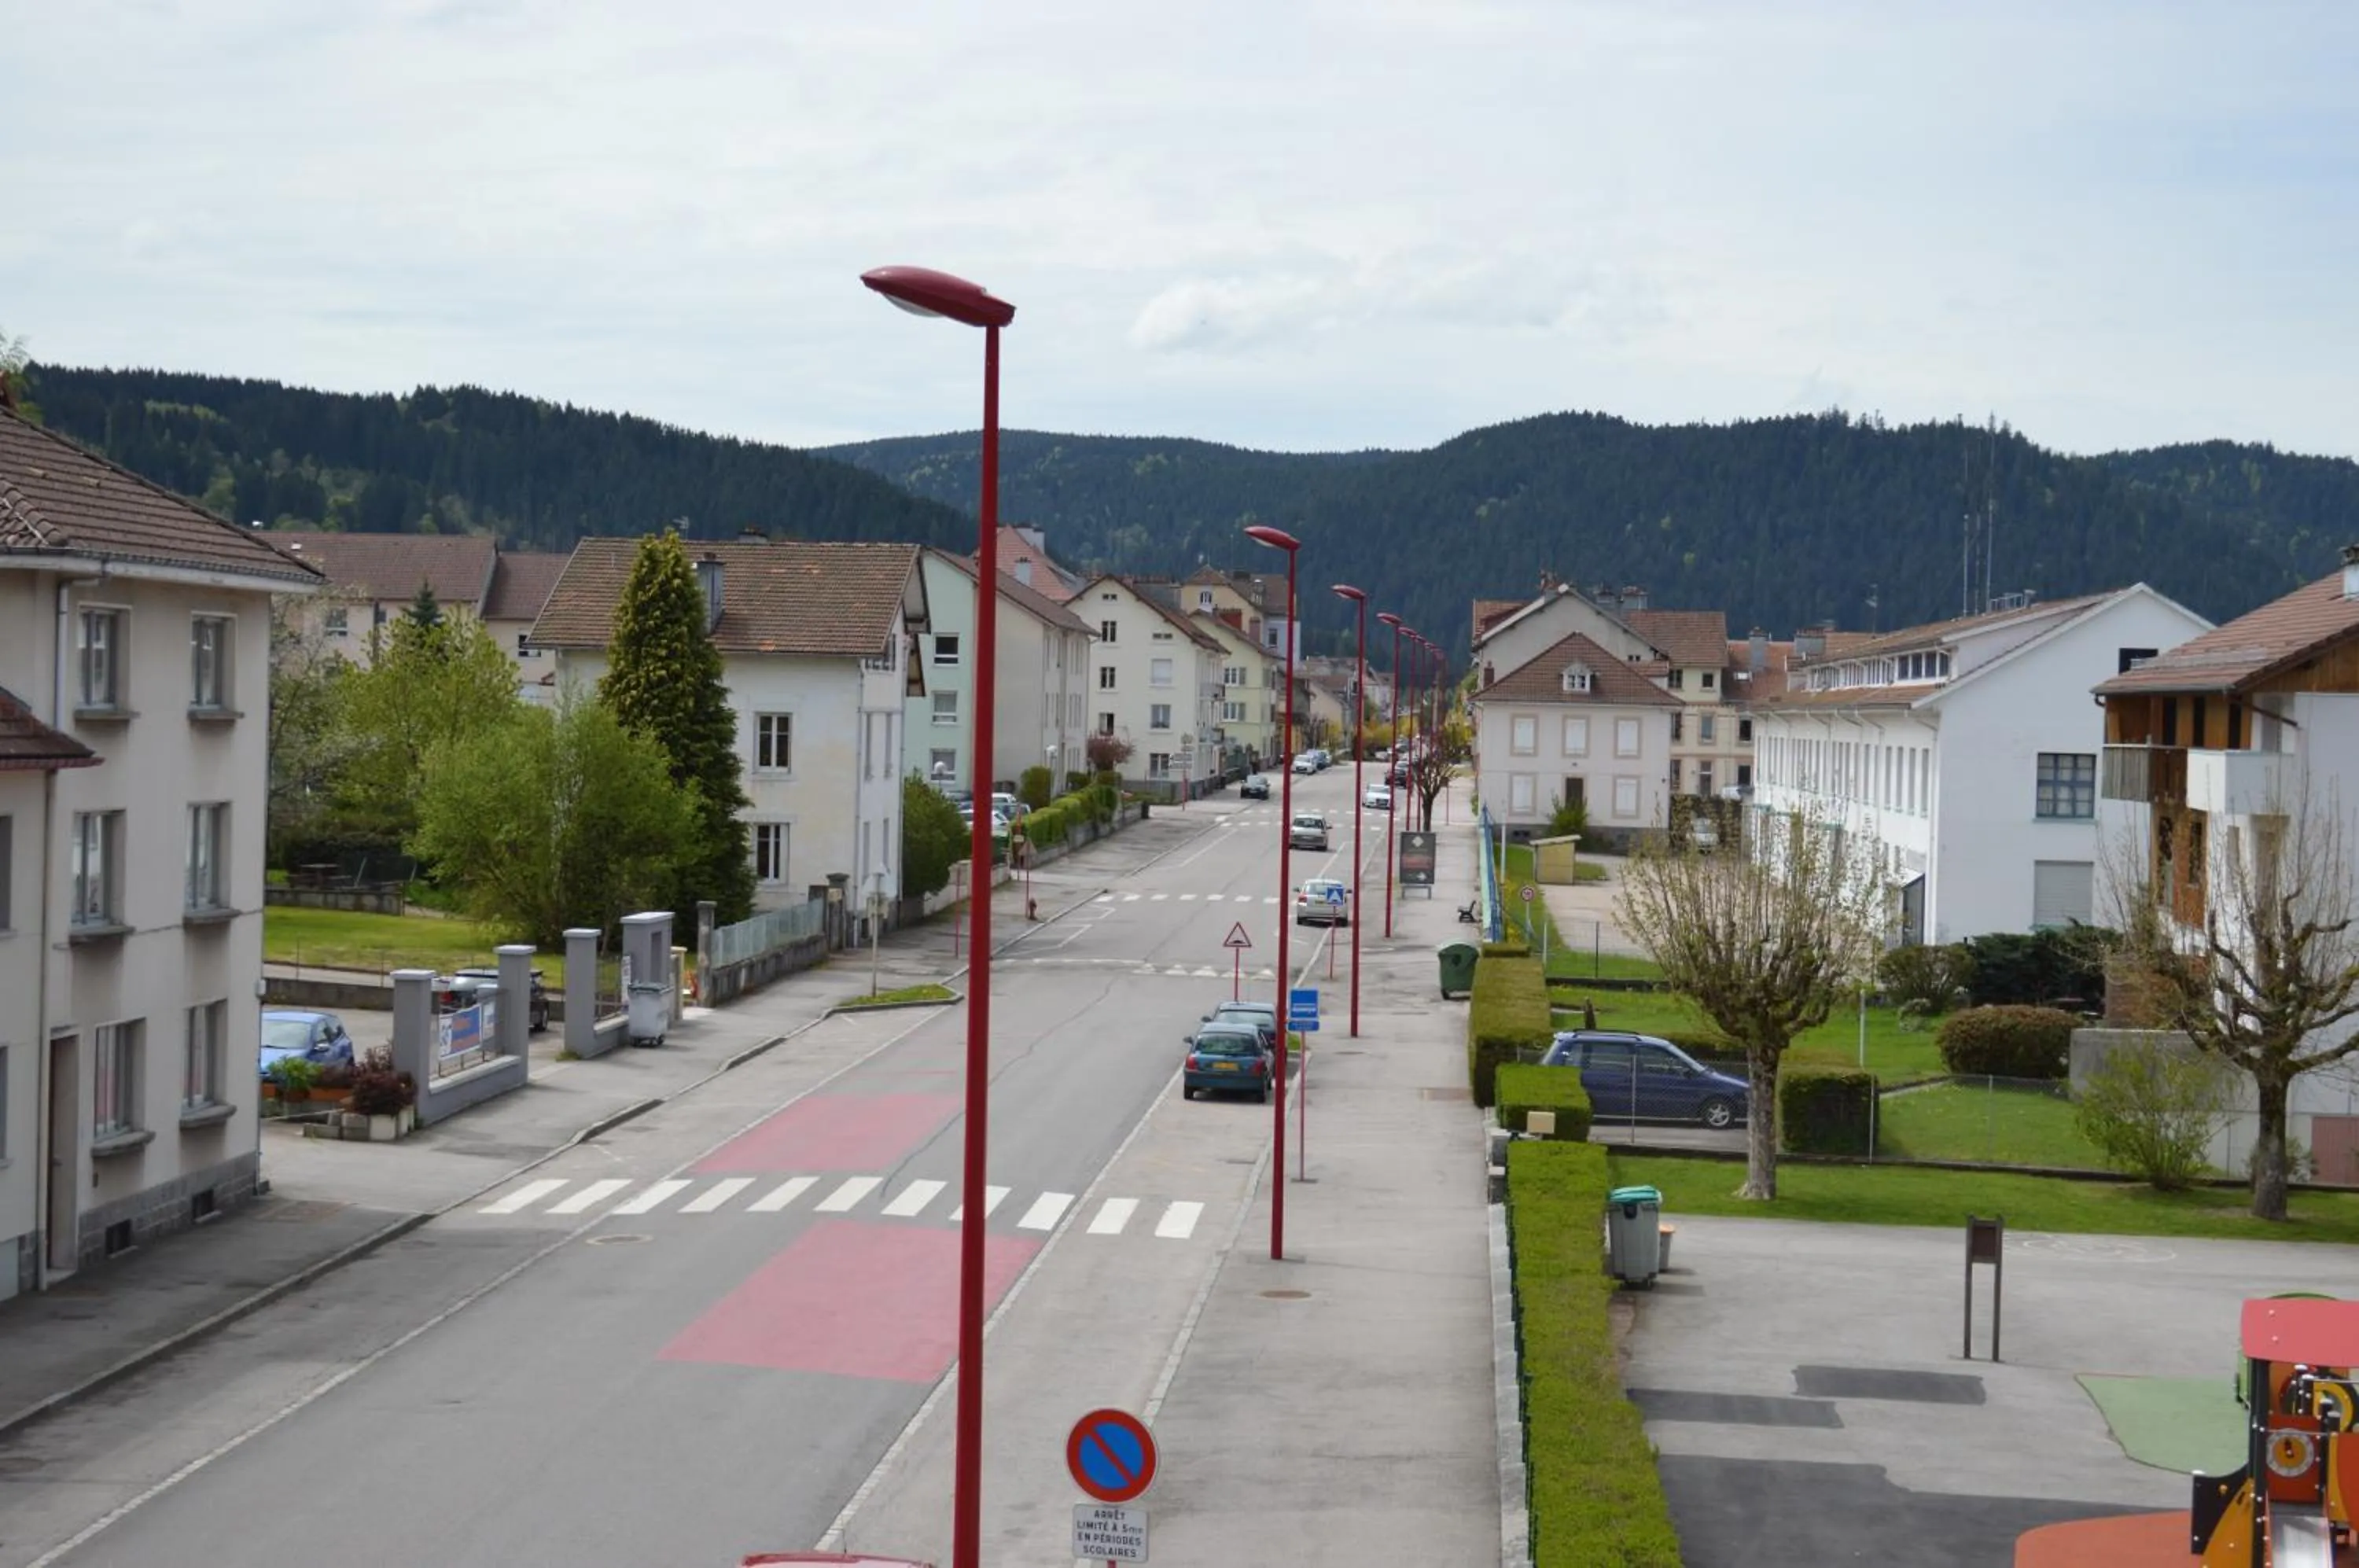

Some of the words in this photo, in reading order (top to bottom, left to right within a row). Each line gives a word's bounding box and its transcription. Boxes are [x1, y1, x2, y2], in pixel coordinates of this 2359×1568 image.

[1077, 1532, 1091, 1541] EN
[1094, 1533, 1141, 1546] PÉRIODES
[1083, 1544, 1136, 1558] SCOLAIRES
